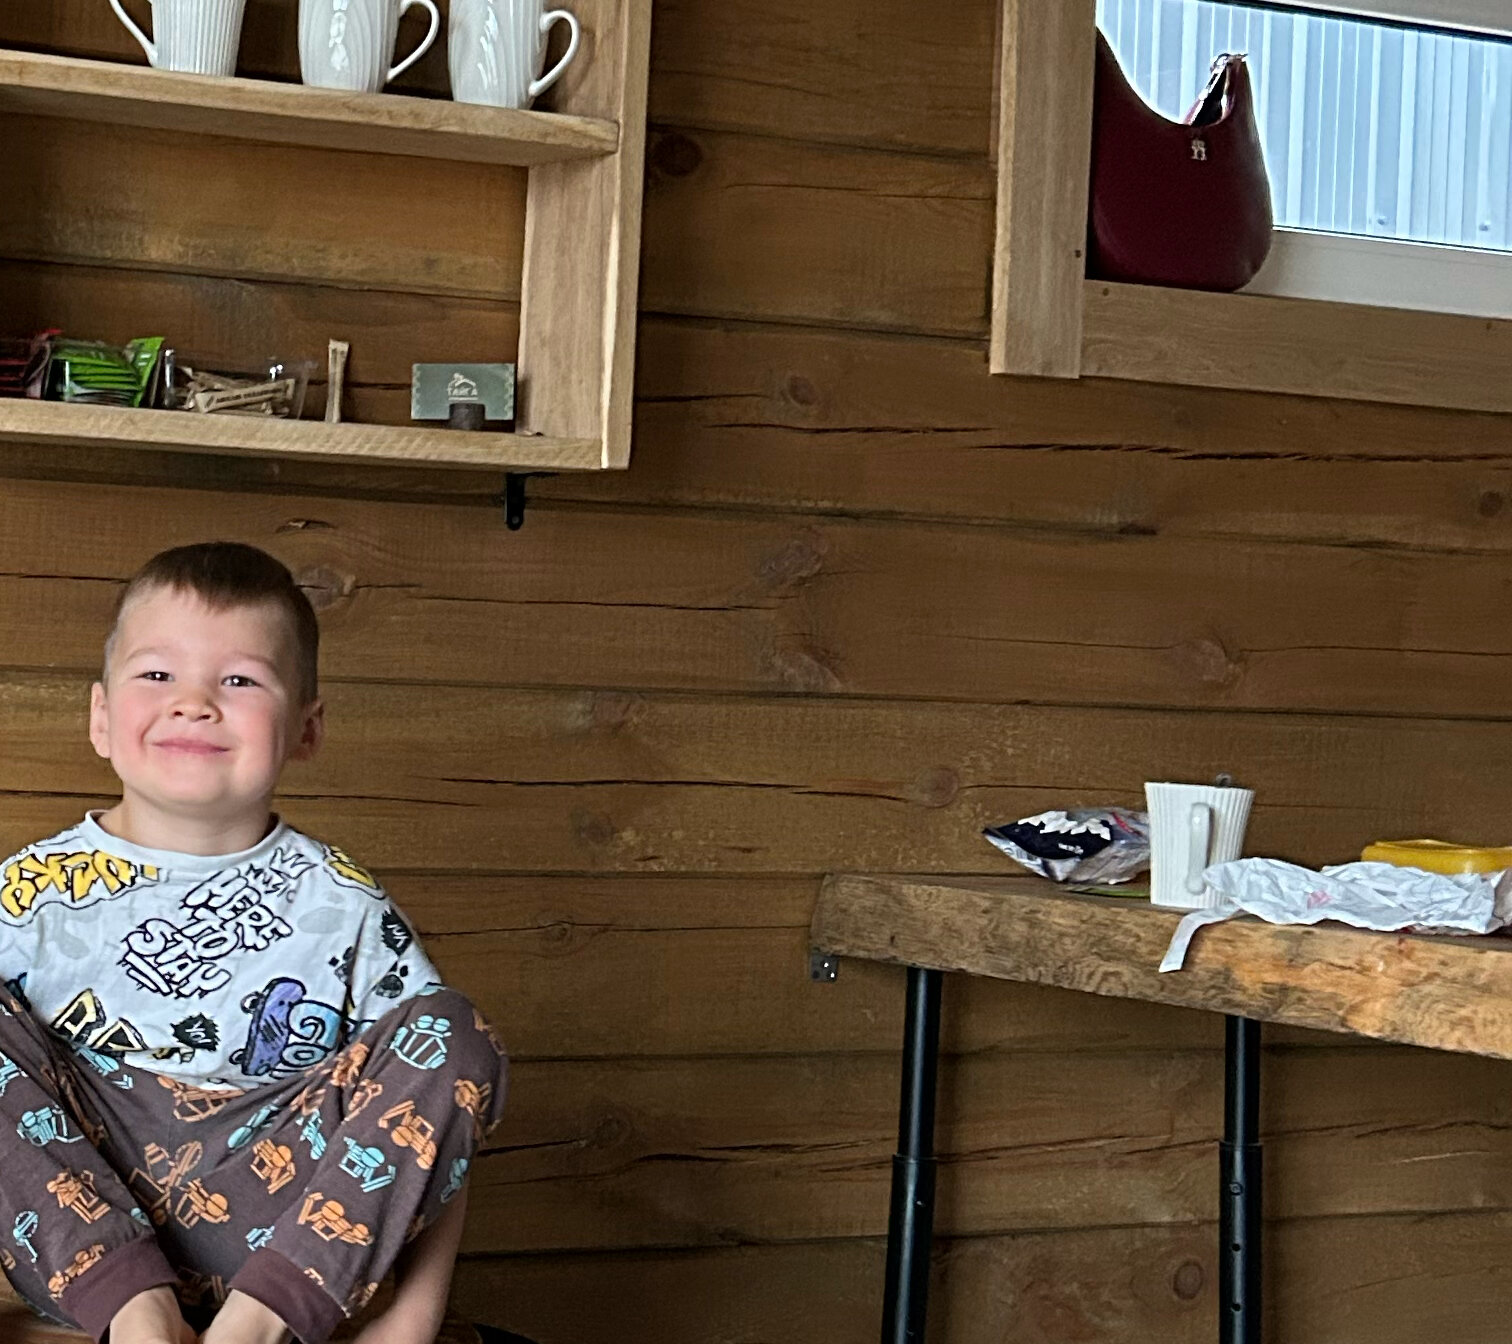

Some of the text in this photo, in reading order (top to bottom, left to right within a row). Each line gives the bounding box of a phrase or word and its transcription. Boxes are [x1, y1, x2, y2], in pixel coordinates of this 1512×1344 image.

[180, 907, 239, 960] TO
[181, 867, 293, 951] HERE
[124, 918, 232, 998] STAY
